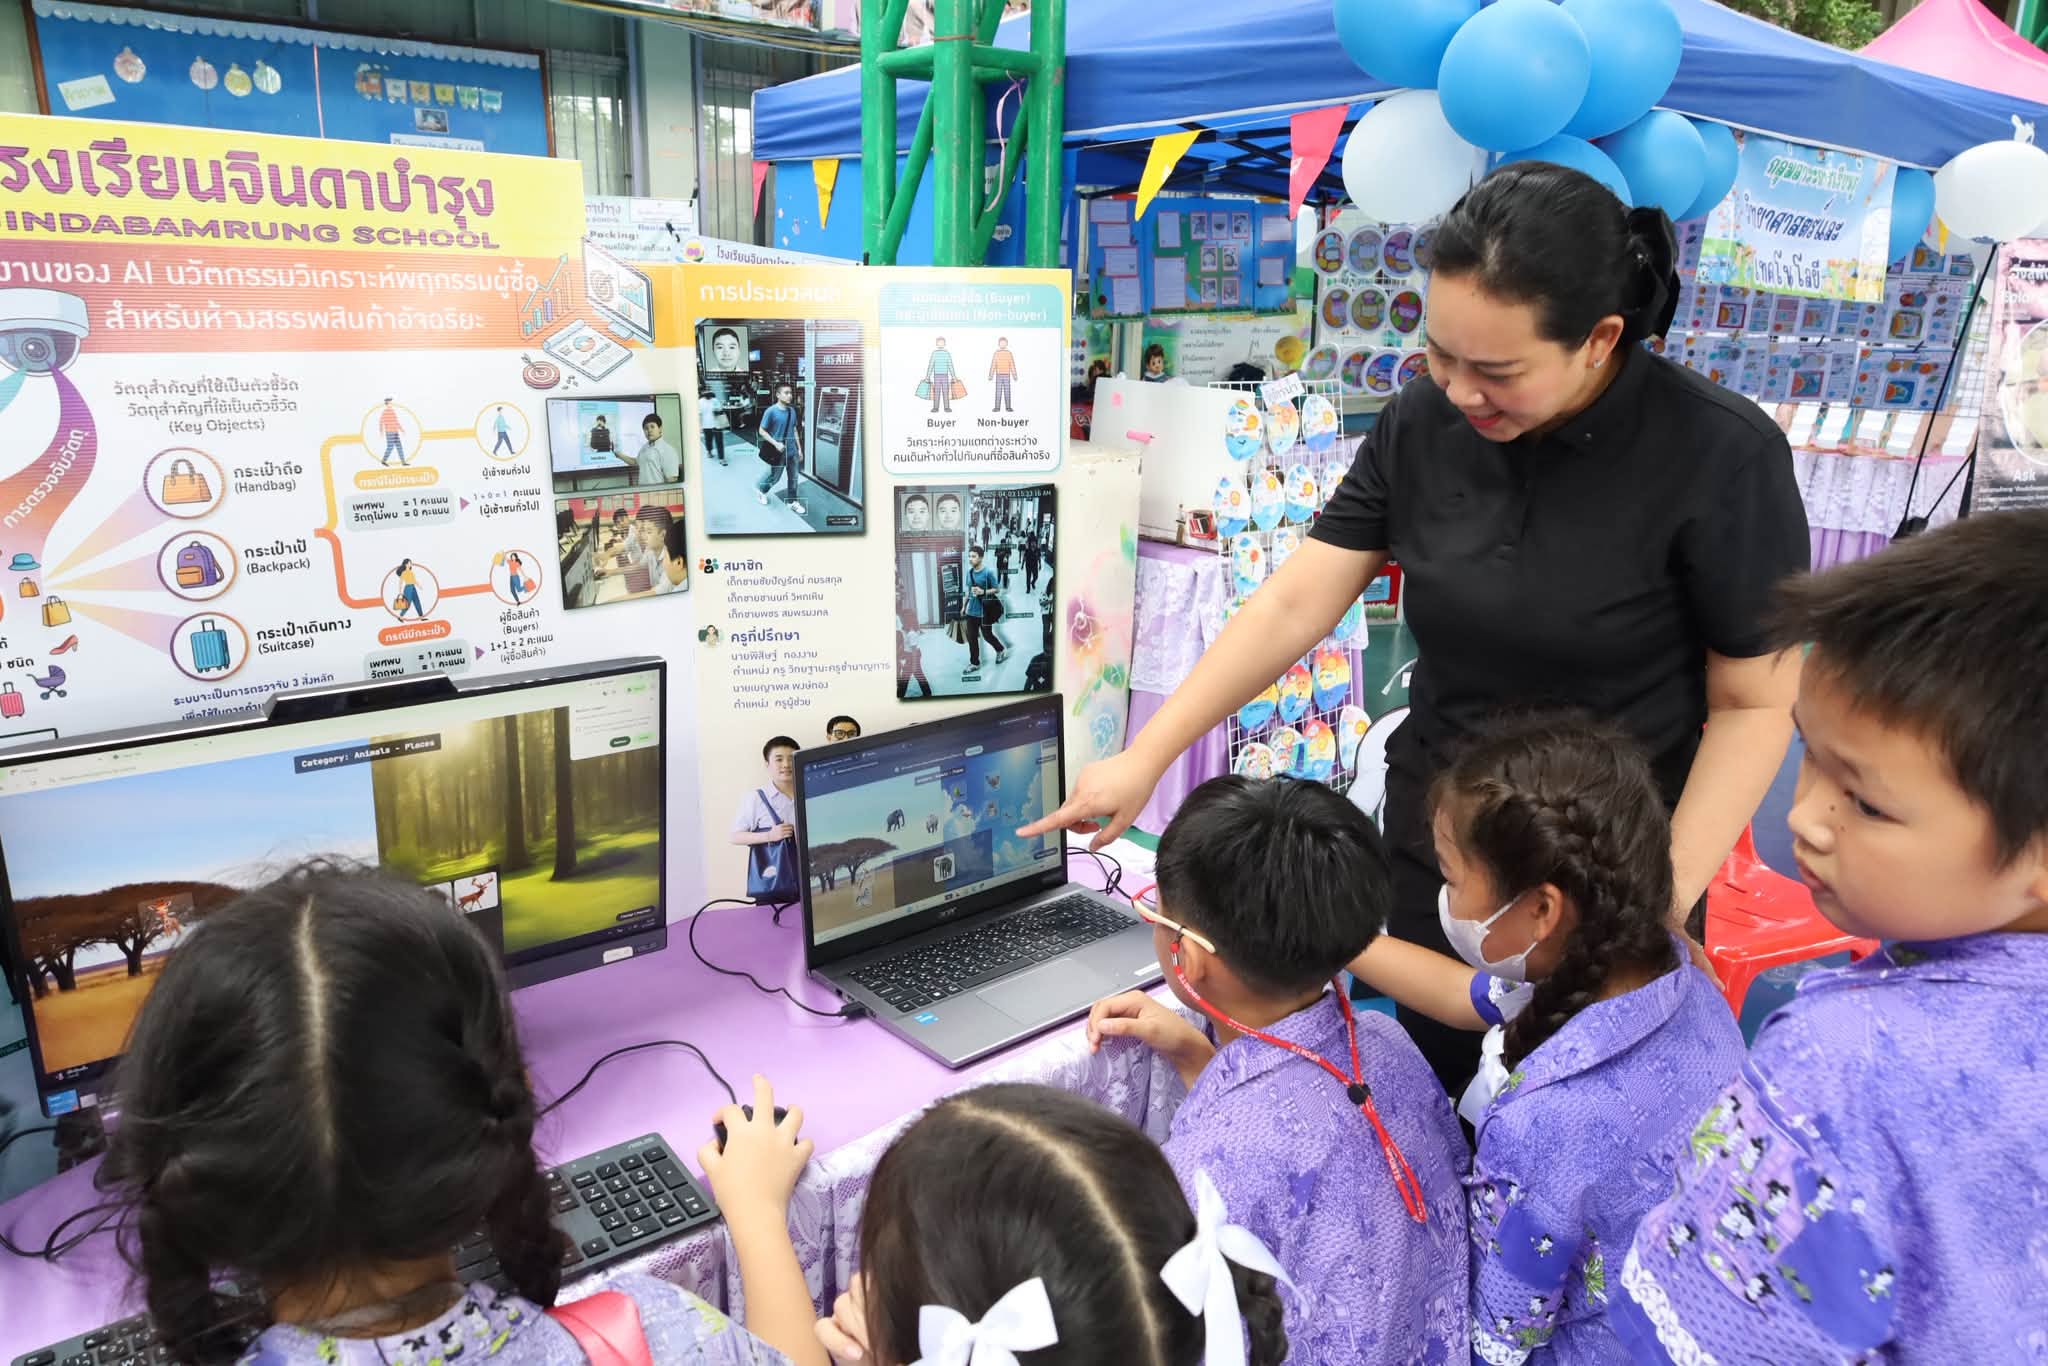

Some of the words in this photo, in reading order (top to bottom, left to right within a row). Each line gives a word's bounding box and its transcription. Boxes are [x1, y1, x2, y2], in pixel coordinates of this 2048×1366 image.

[0, 210, 341, 242] INDABAMRUNG
[352, 225, 500, 249] SCHOOL
[123, 260, 154, 285] AI
[169, 421, 202, 434] (Key
[206, 419, 265, 434] Objects)
[927, 418, 957, 429] Buyer
[977, 417, 1030, 429] Non-buyer
[233, 461, 303, 478] กระเป๋าถือ
[234, 479, 297, 495] (Handbag)
[244, 540, 307, 559] กระเป๋าเป้
[246, 557, 311, 576] (Backpack)
[723, 559, 763, 572] สมาชิก
[256, 617, 352, 642] กระเป๋าเดินทาง
[502, 621, 539, 635] (Buyers)
[731, 626, 800, 646] ครูที่ปรึกษา
[258, 637, 315, 655] (Suitcase)
[7, 657, 35, 669] ชนิด
[301, 753, 349, 768] Category:
[354, 746, 390, 760] Animals
[404, 739, 435, 751] Places
